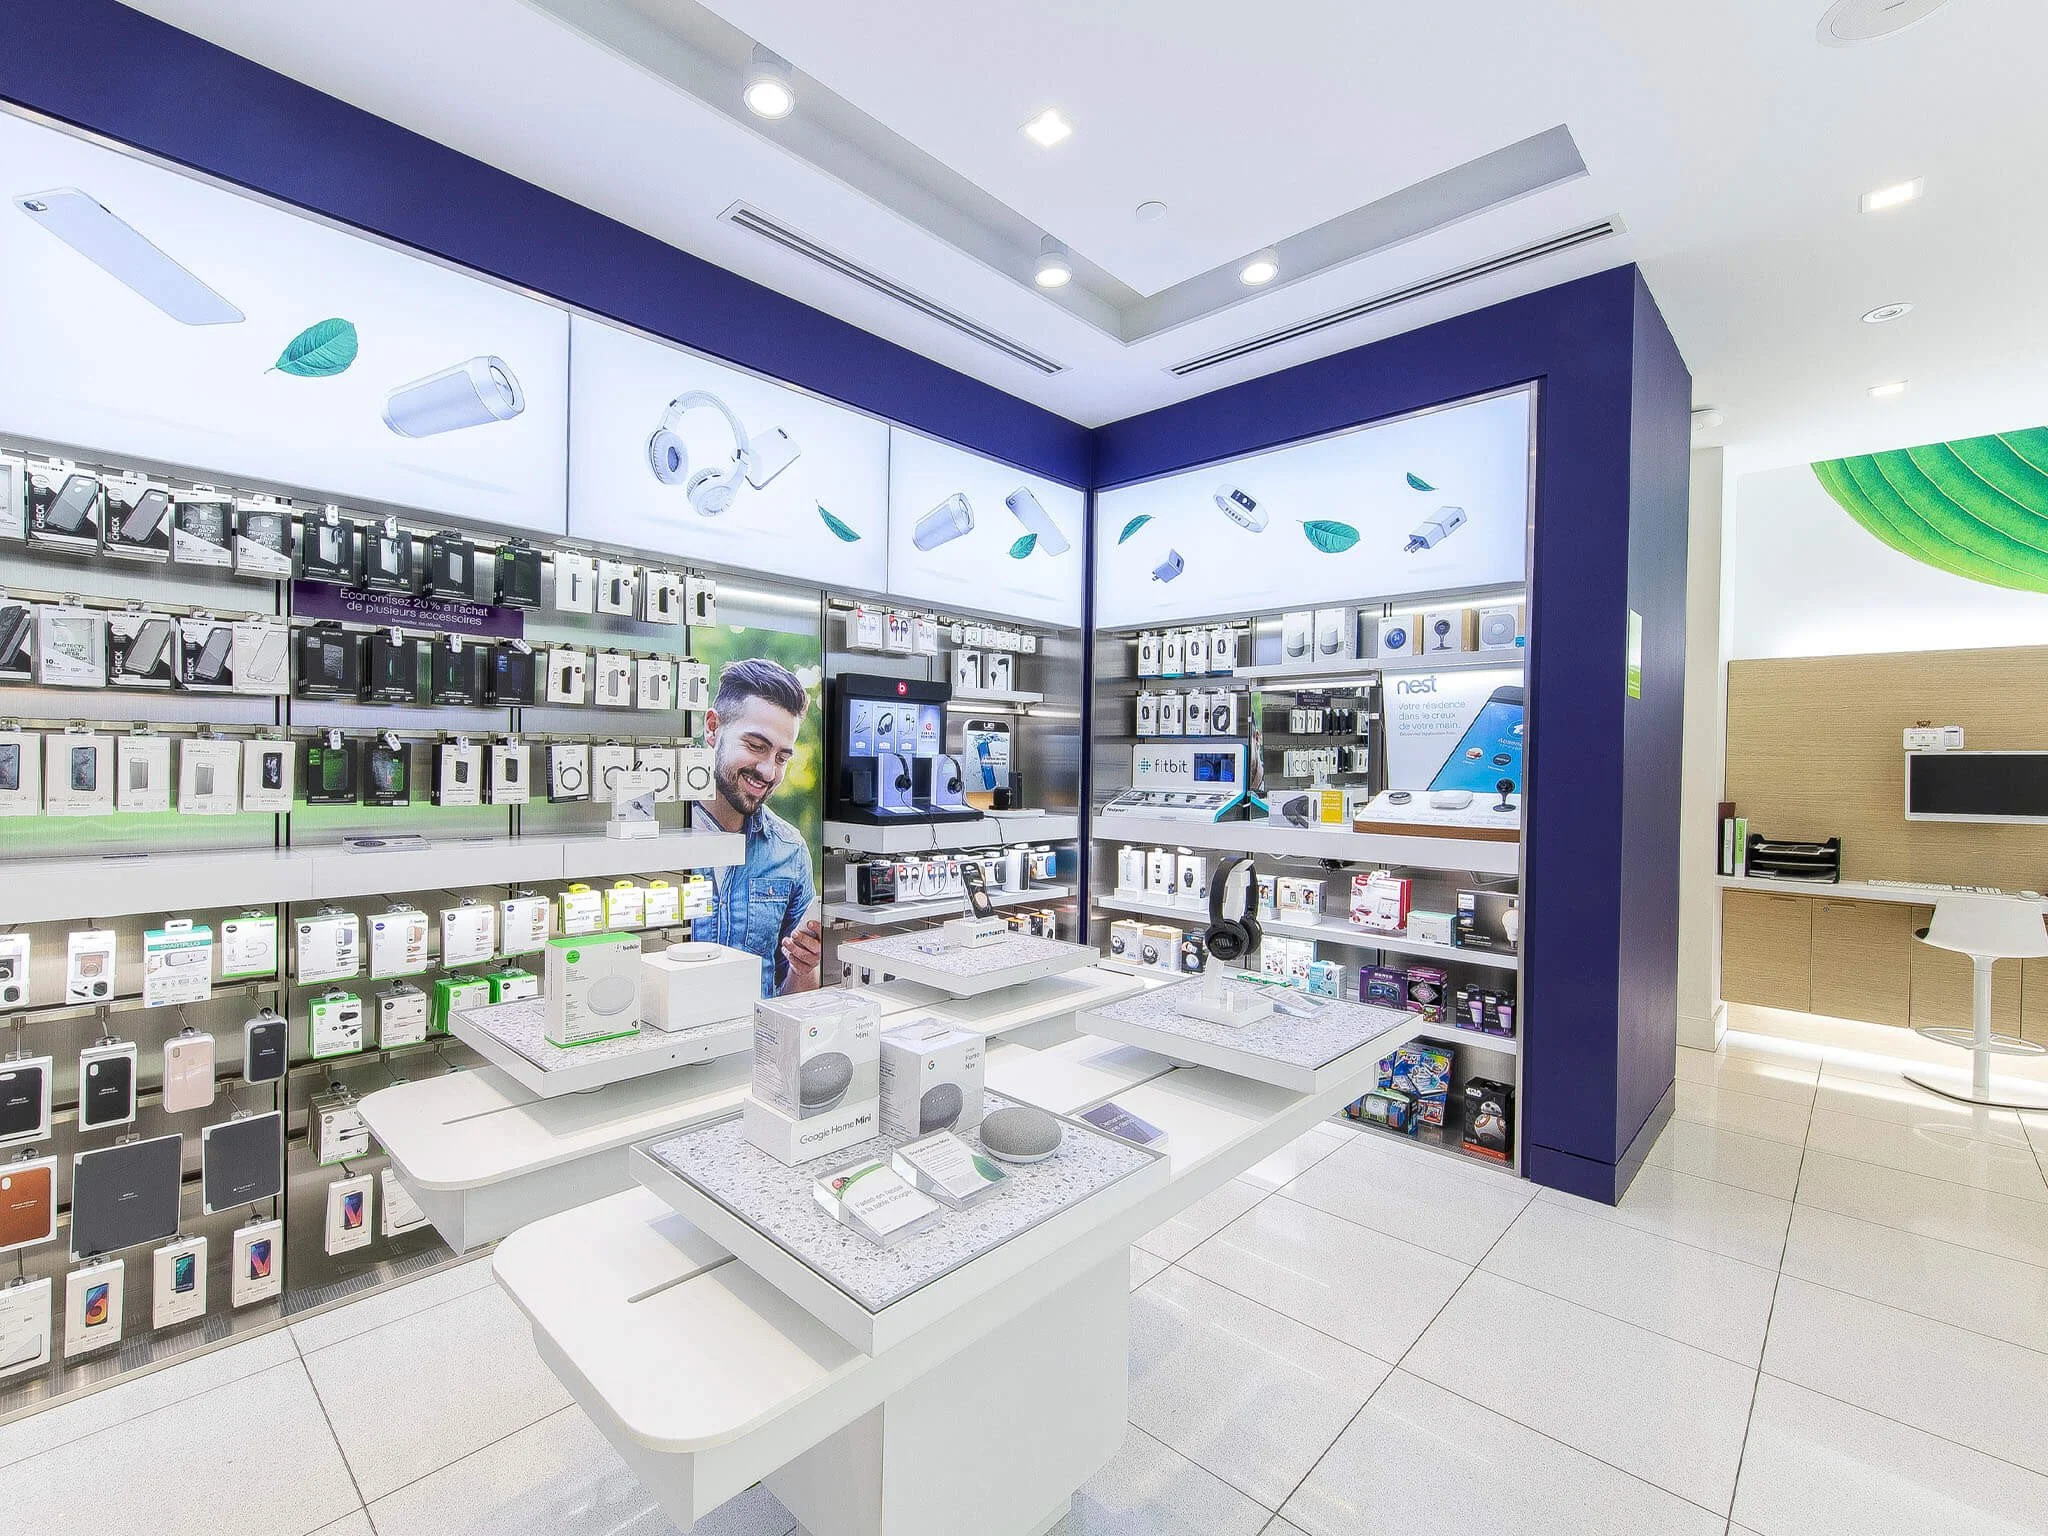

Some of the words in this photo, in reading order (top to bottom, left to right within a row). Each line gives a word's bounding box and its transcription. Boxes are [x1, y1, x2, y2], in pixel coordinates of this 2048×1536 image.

[36, 504, 45, 528] CHECK
[112, 517, 120, 540] CHECK
[340, 586, 411, 607] Économisez
[413, 598, 429, 609] 20
[430, 601, 441, 611] %
[453, 604, 488, 617] l'achat
[347, 601, 362, 611] de
[366, 603, 417, 618] plusieurs
[419, 609, 482, 626] accessoires
[1397, 675, 1437, 695] nest
[1398, 702, 1420, 711] Votre
[1422, 701, 1466, 710] résidence
[1399, 712, 1420, 721] dans
[1431, 712, 1456, 720] creux
[1399, 722, 1411, 731] de
[1412, 722, 1434, 730] votre
[1435, 721, 1461, 729] main.
[1154, 758, 1189, 773] fitbit
[1215, 937, 1233, 947] JBL
[855, 1031, 869, 1040] Mini
[799, 1127, 831, 1145] Google
[831, 1121, 855, 1134] Home
[855, 1113, 872, 1127] Mini
